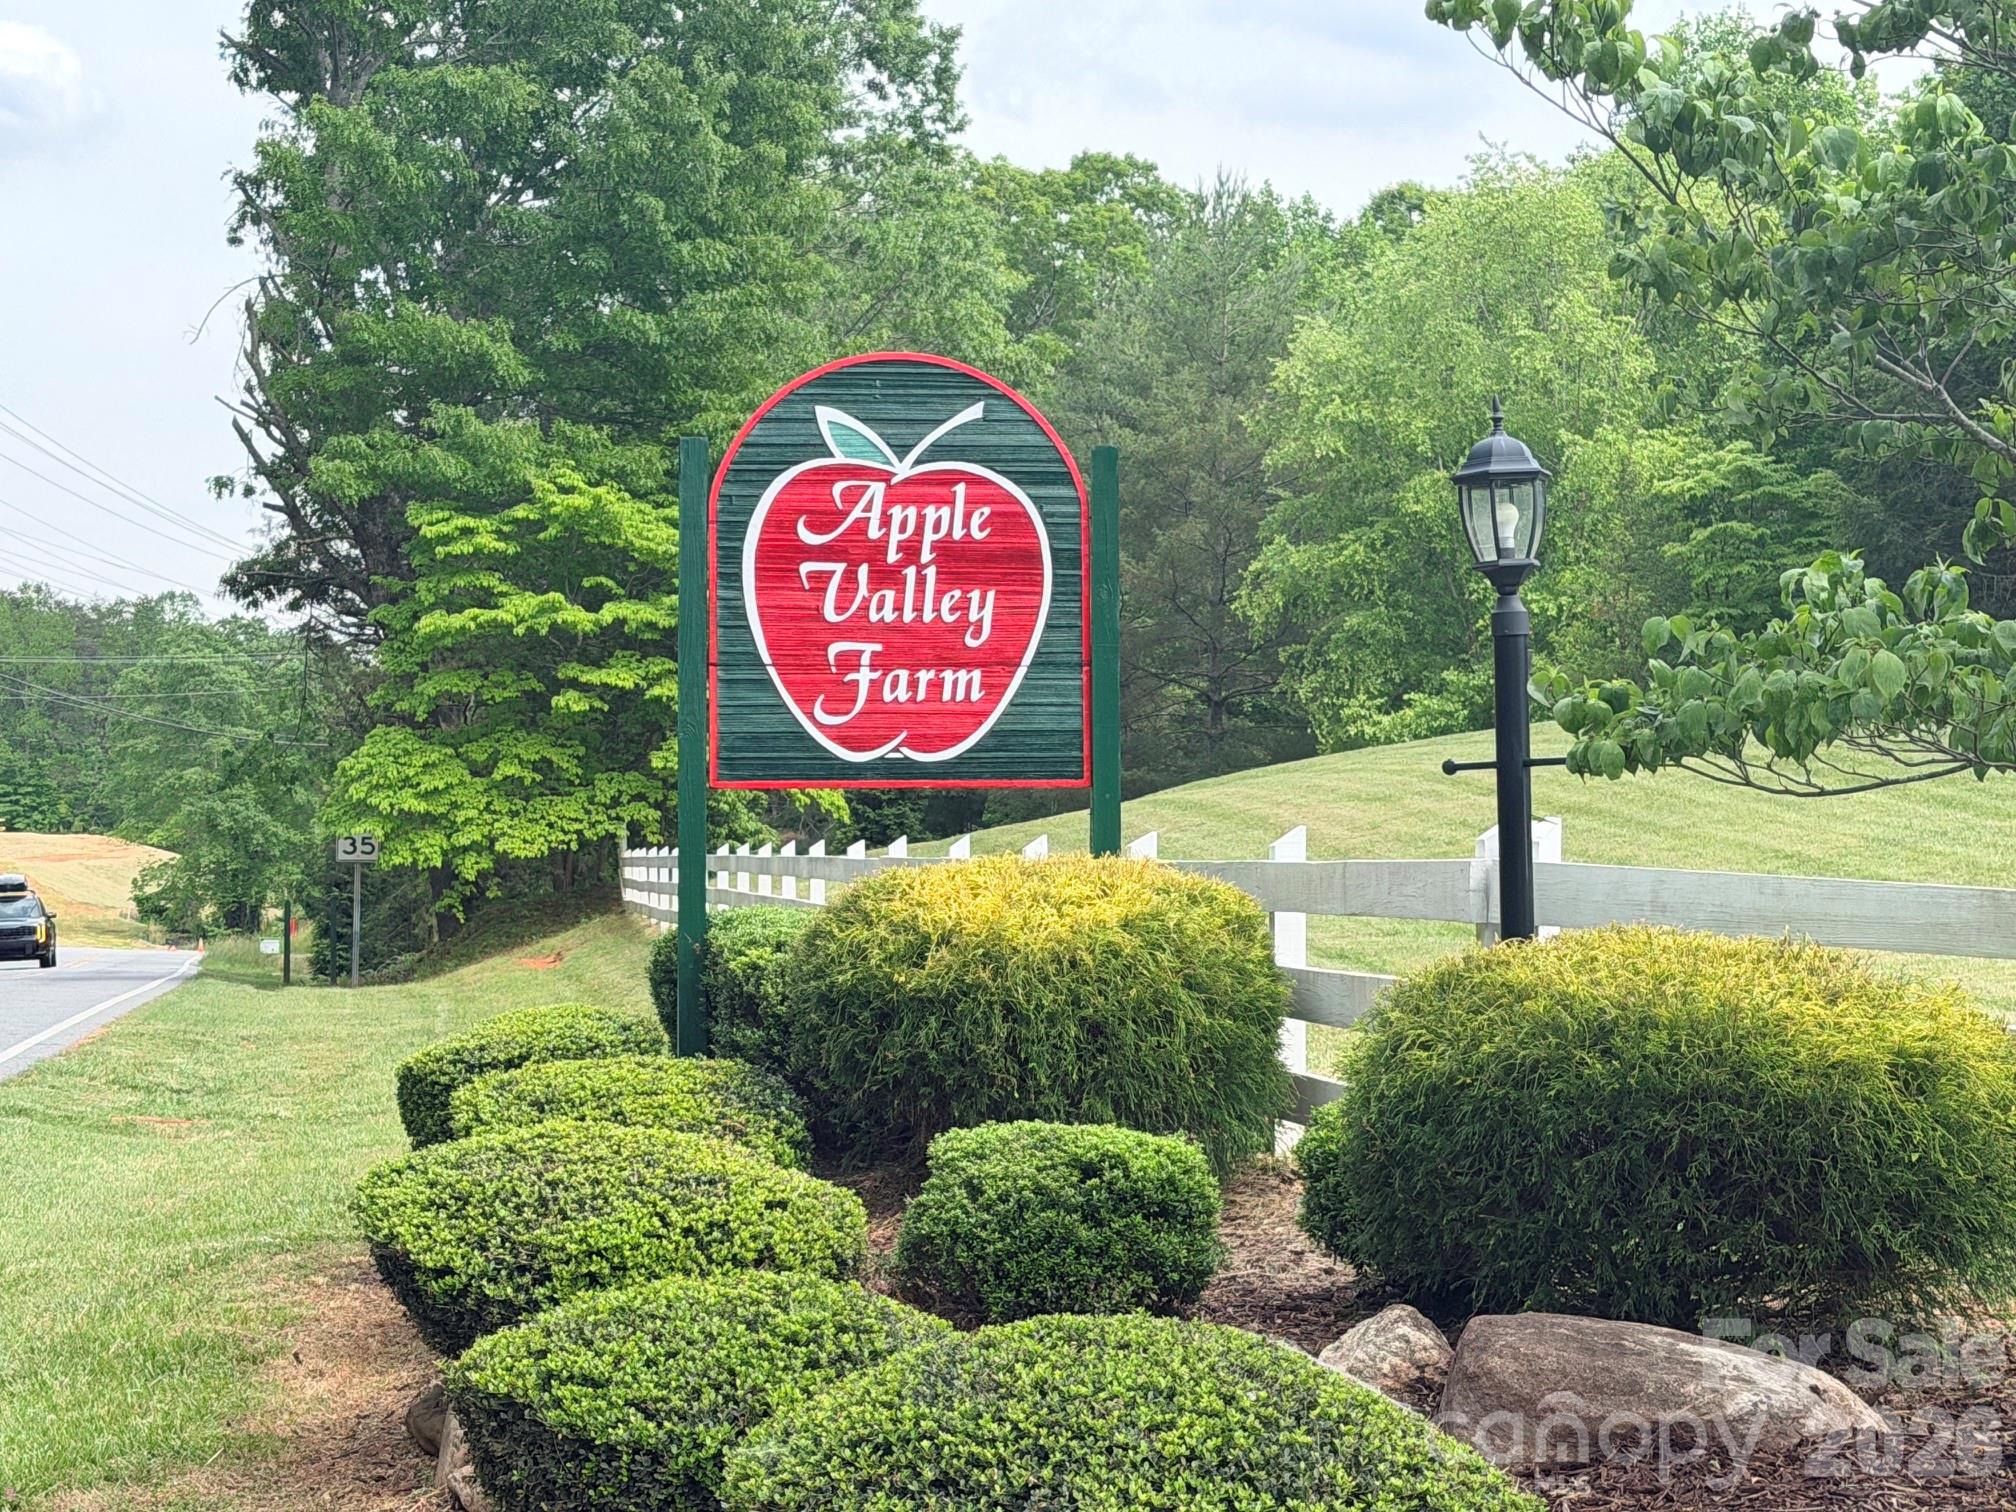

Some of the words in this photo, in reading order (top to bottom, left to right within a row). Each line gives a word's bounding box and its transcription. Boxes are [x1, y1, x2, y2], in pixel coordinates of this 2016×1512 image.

[796, 479, 992, 565] Apple
[799, 561, 996, 649] Valley
[813, 641, 986, 726] Farm
[342, 836, 376, 855] 35
